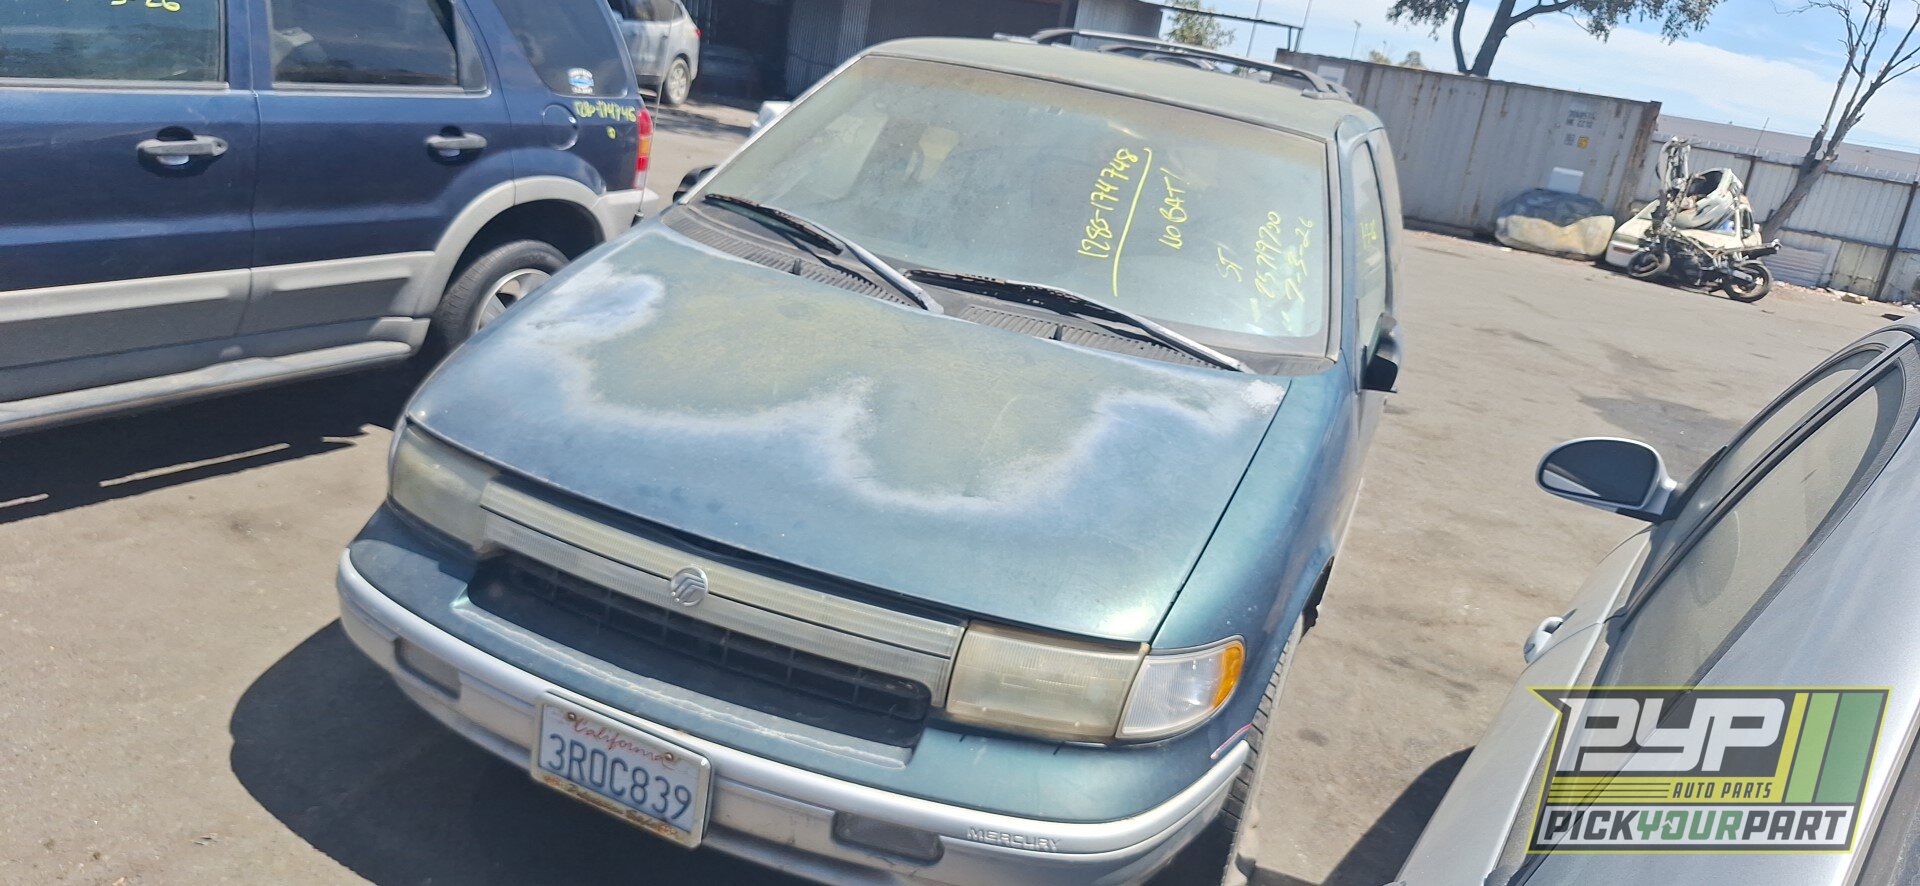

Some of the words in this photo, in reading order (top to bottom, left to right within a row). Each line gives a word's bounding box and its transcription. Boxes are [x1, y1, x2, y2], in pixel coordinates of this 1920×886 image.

[1077, 148, 1138, 258] 1285-174748
[574, 718, 668, 764] California
[548, 734, 692, 820] 3ROC839
[967, 826, 1059, 852] MERCURY
